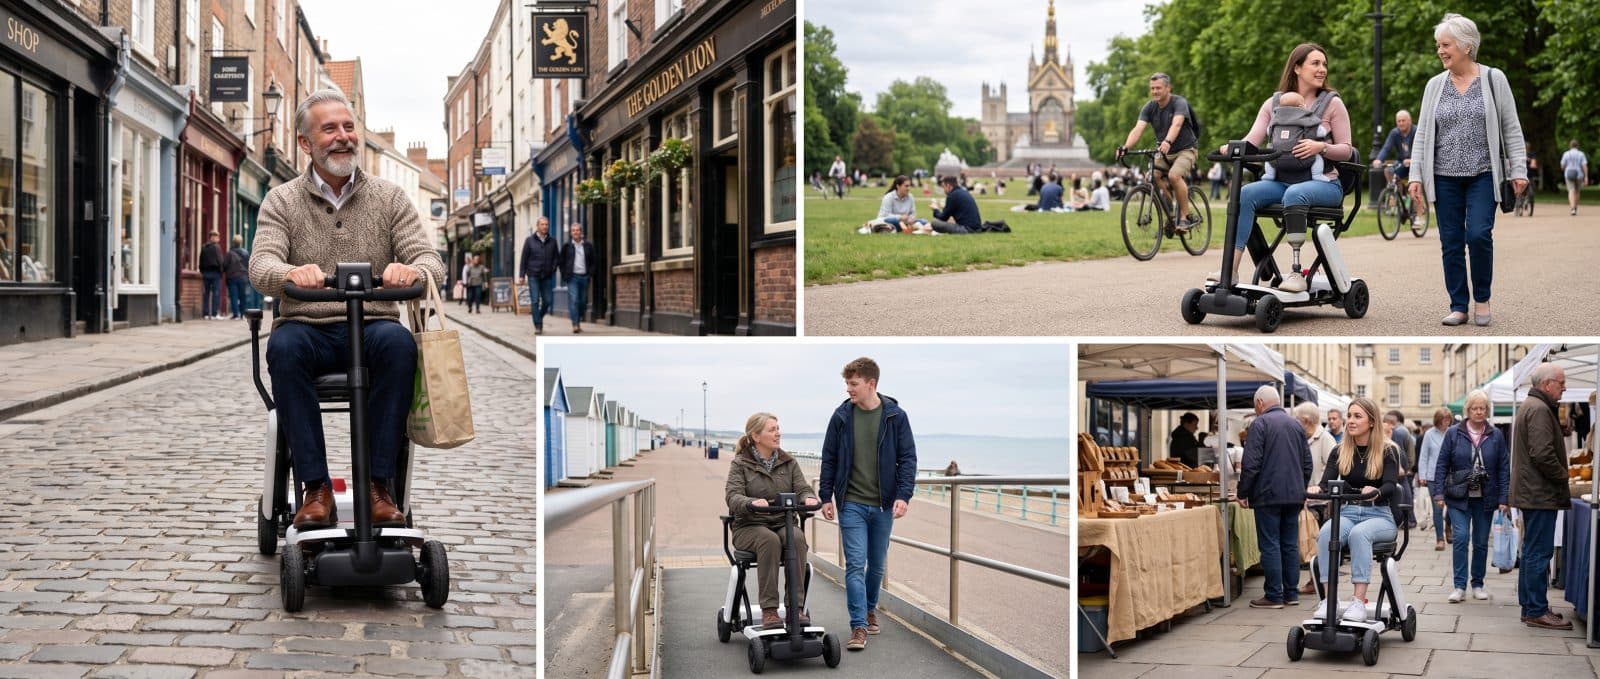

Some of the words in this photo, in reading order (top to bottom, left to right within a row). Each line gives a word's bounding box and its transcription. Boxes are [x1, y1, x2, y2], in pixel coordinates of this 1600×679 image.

[8, 17, 39, 53] SHOP
[626, 89, 643, 118] THE
[643, 59, 685, 106] GOLDEN
[685, 36, 716, 78] LION
